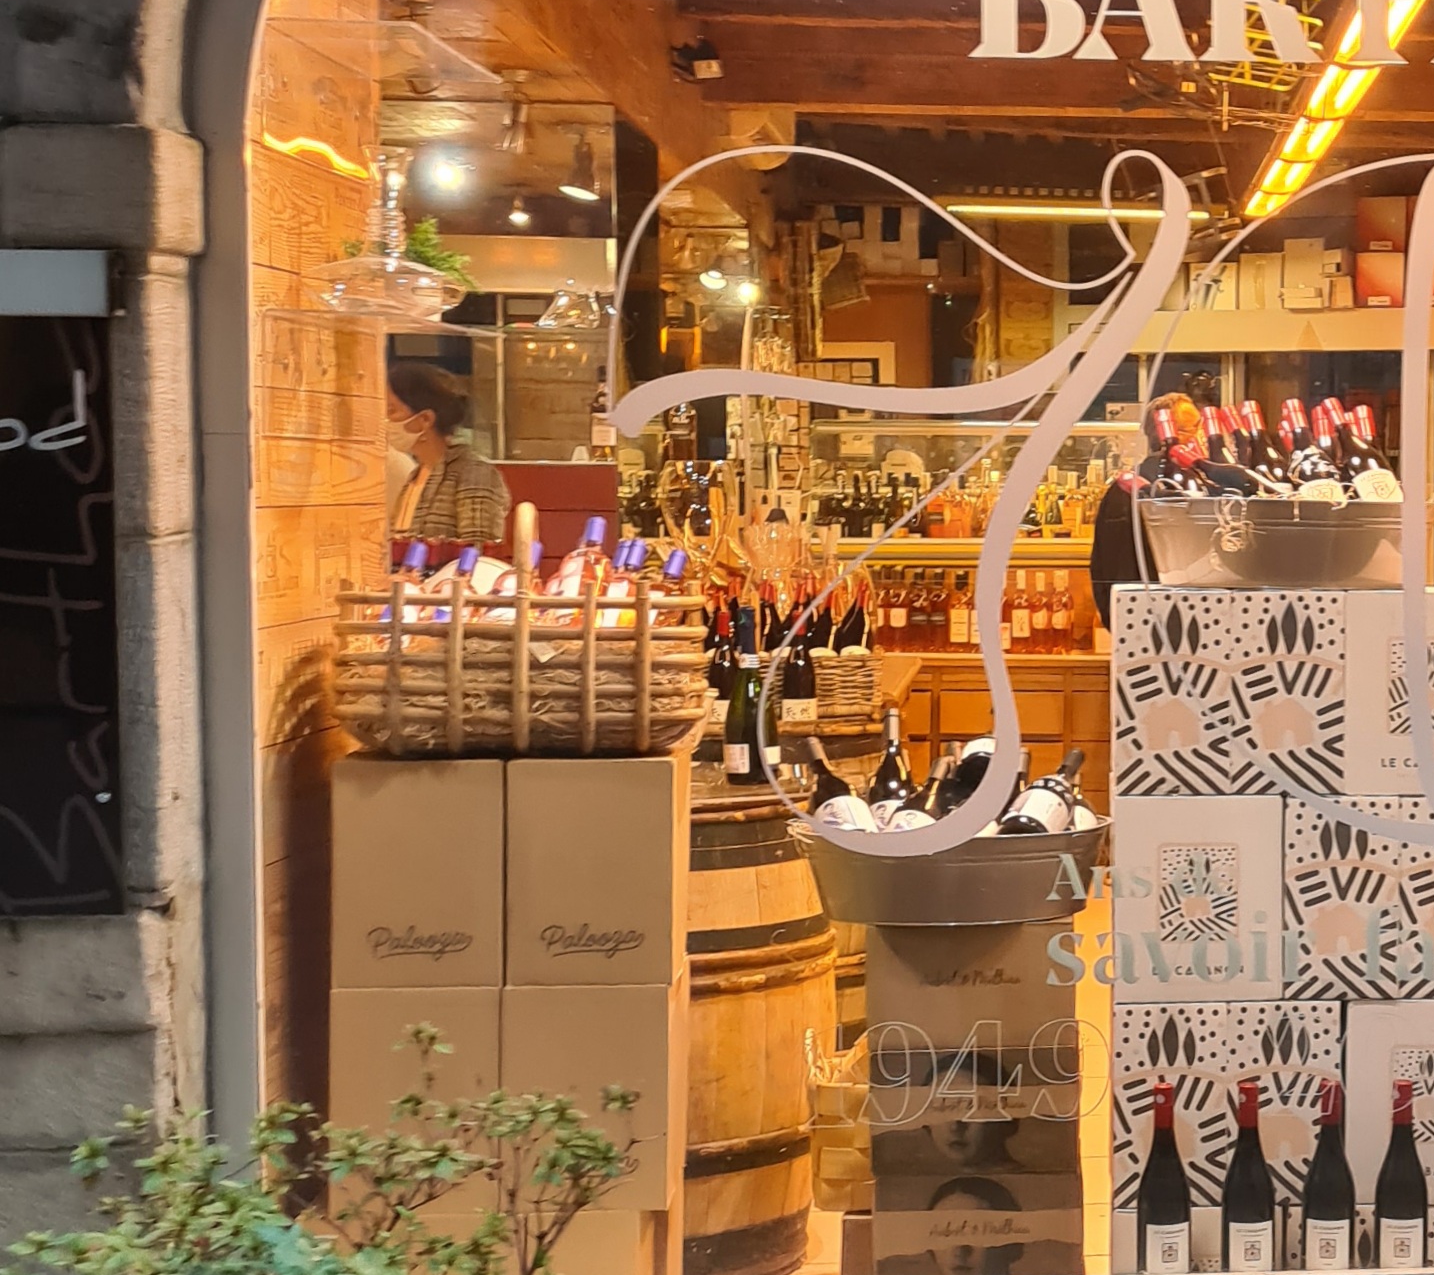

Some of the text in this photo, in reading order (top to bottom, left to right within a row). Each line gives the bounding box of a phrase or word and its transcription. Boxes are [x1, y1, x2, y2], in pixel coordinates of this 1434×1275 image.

[1381, 758, 1397, 768] LE
[1046, 853, 1152, 902] Ans
[1046, 911, 1316, 986] savoir
